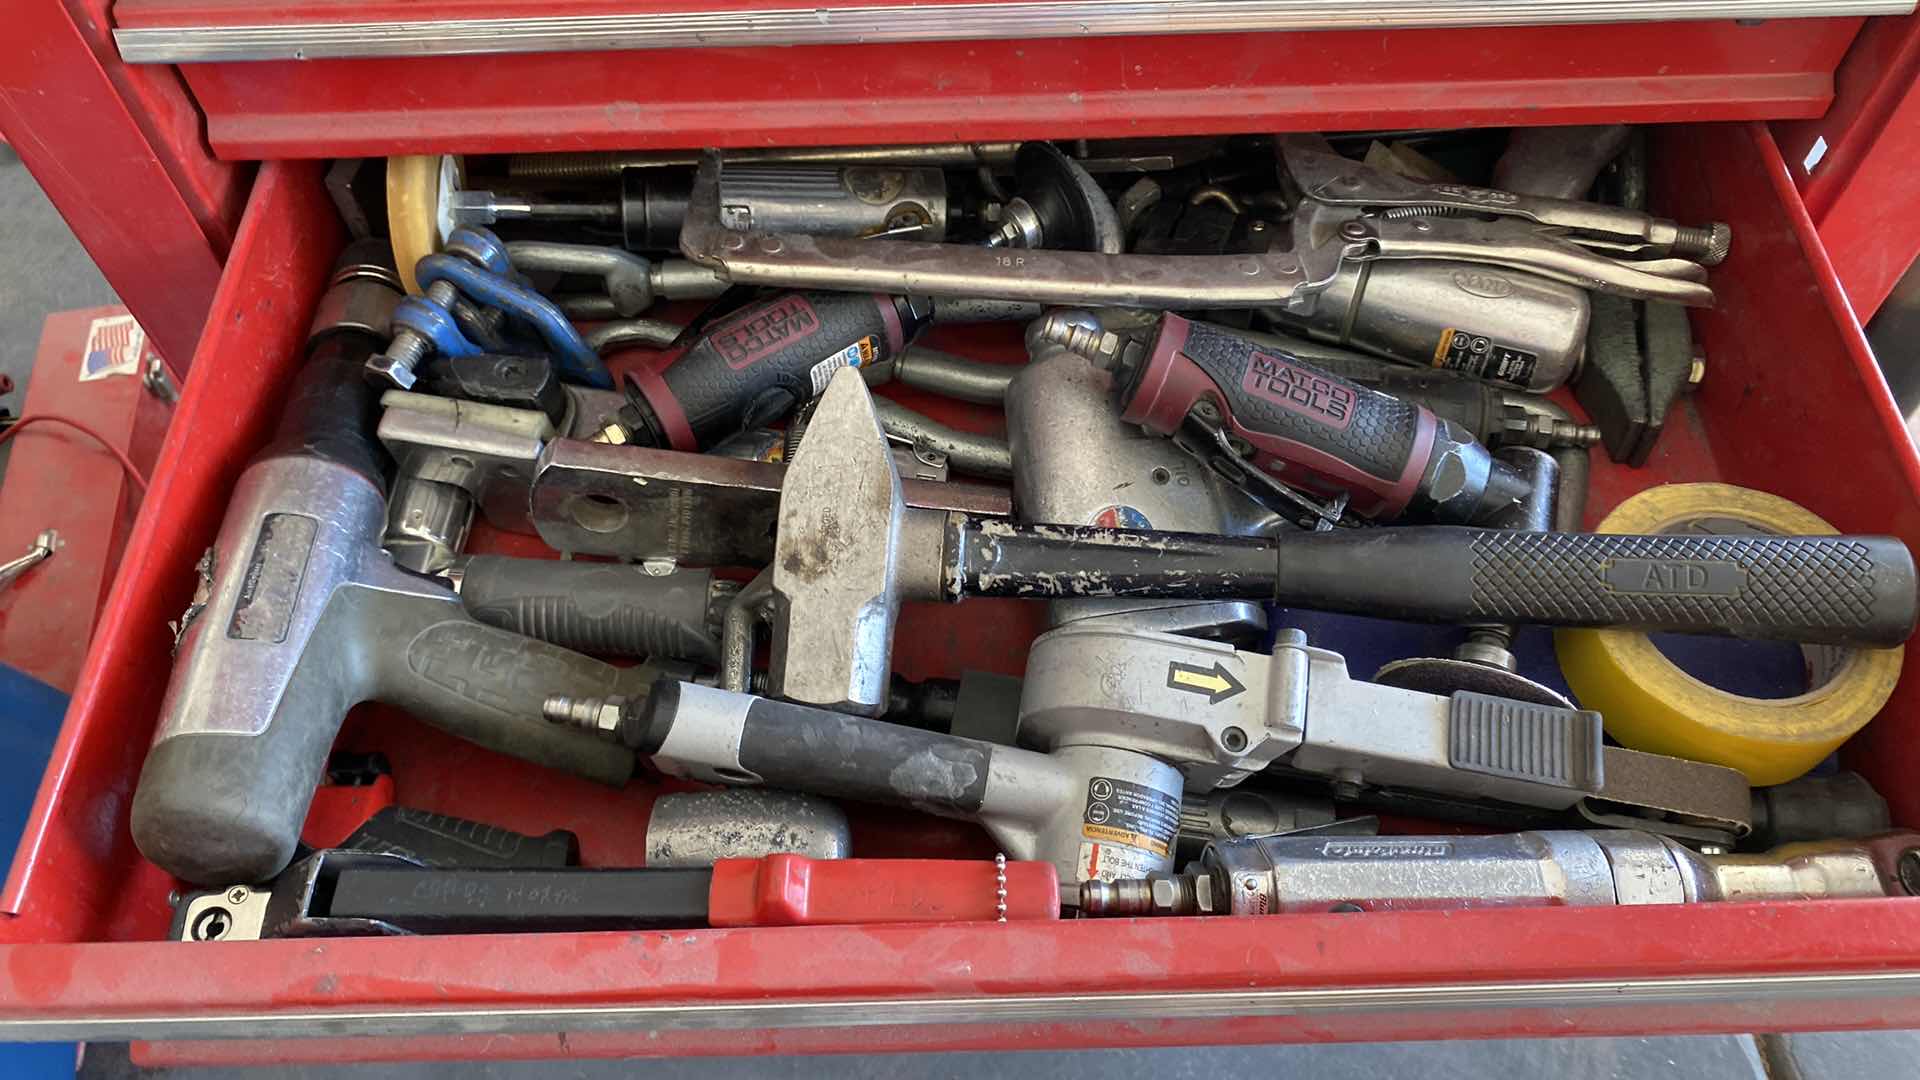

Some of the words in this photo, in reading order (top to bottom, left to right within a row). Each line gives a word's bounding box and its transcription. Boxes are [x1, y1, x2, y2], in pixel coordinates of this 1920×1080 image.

[720, 303, 806, 350] TOOLS
[730, 312, 814, 363] MATCO
[1252, 360, 1350, 404] MATCO
[1252, 368, 1347, 421] TOOLS
[1641, 562, 1709, 591] ATD
[1101, 855, 1120, 866] BOLT
